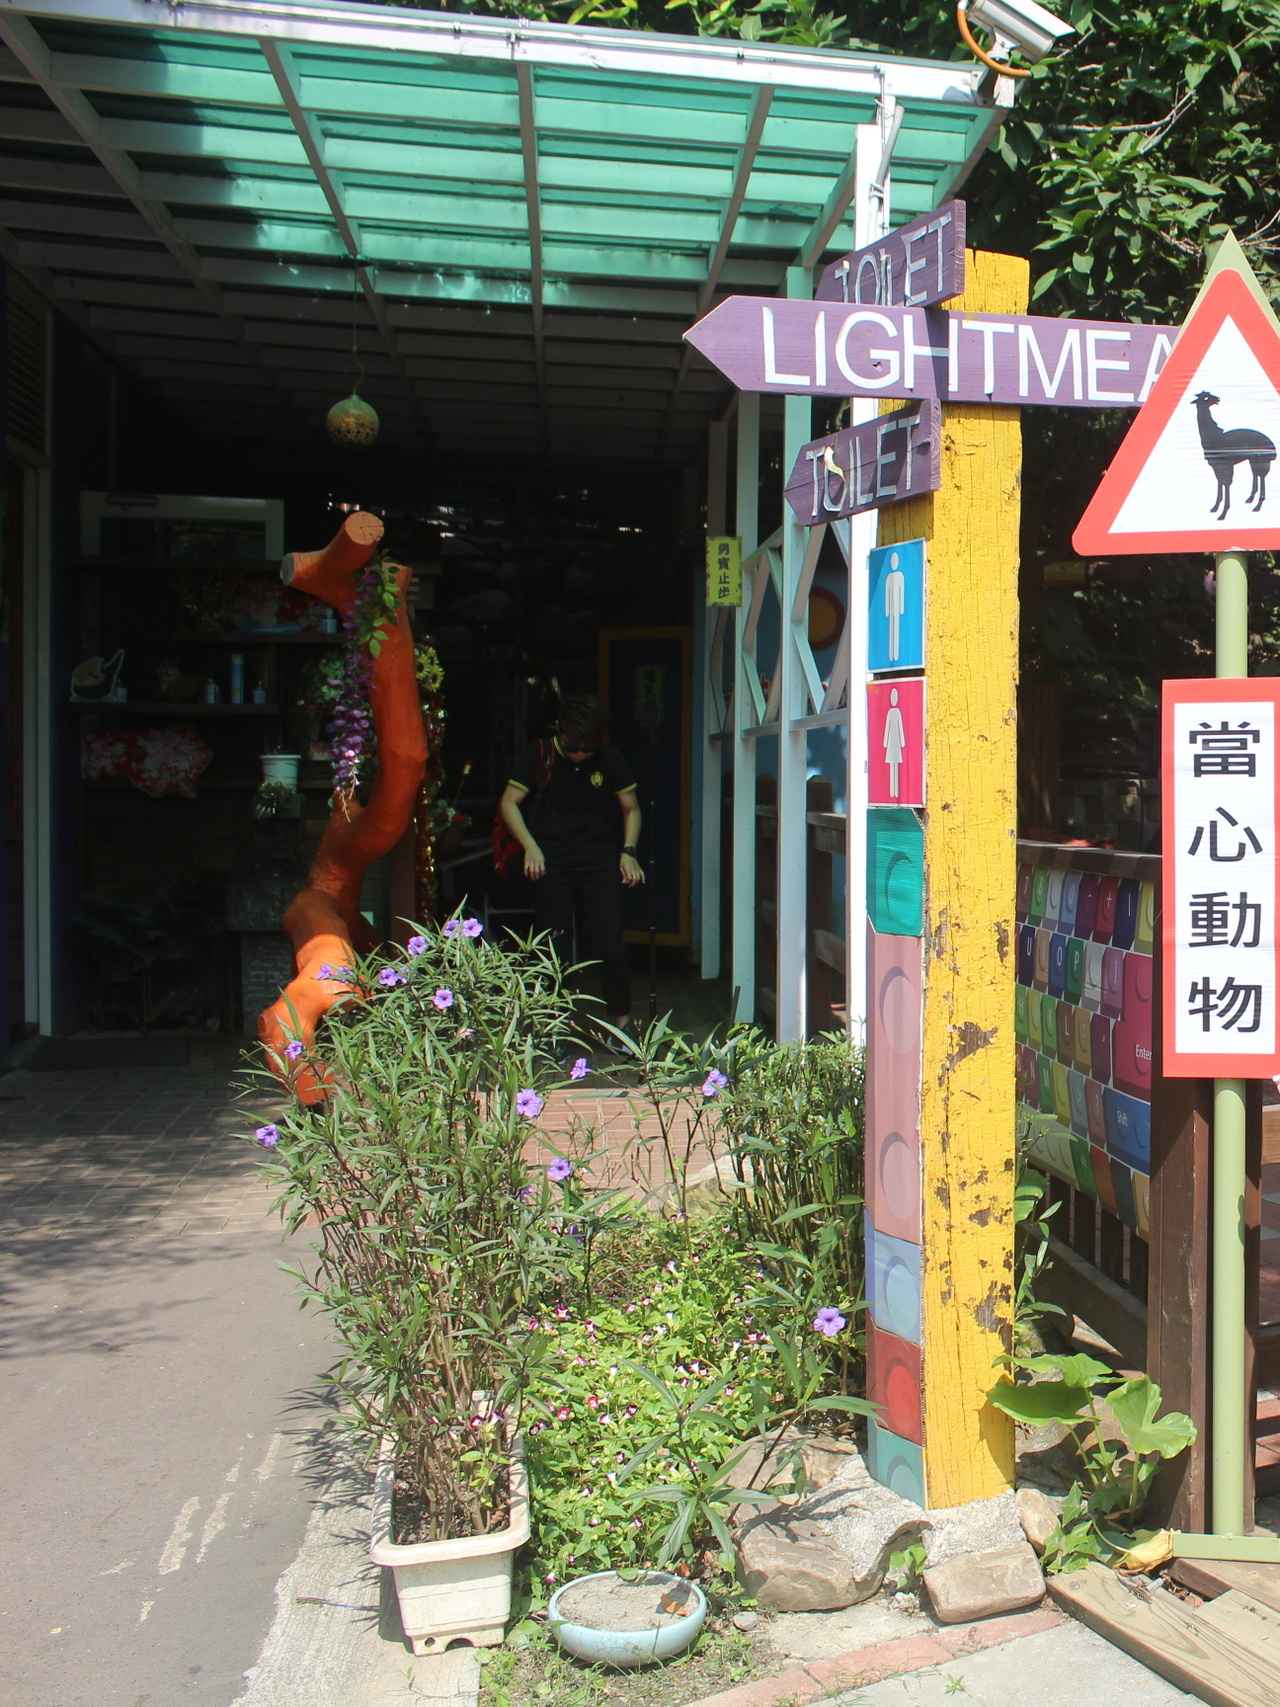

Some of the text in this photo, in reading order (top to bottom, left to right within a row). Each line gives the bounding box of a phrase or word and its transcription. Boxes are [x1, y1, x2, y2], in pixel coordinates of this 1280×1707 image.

[805, 413, 921, 517] TOILET
[1187, 720, 1264, 1034] 當心動物
[1134, 1043, 1153, 1062] Enter
[1116, 1109, 1129, 1128] Shift
